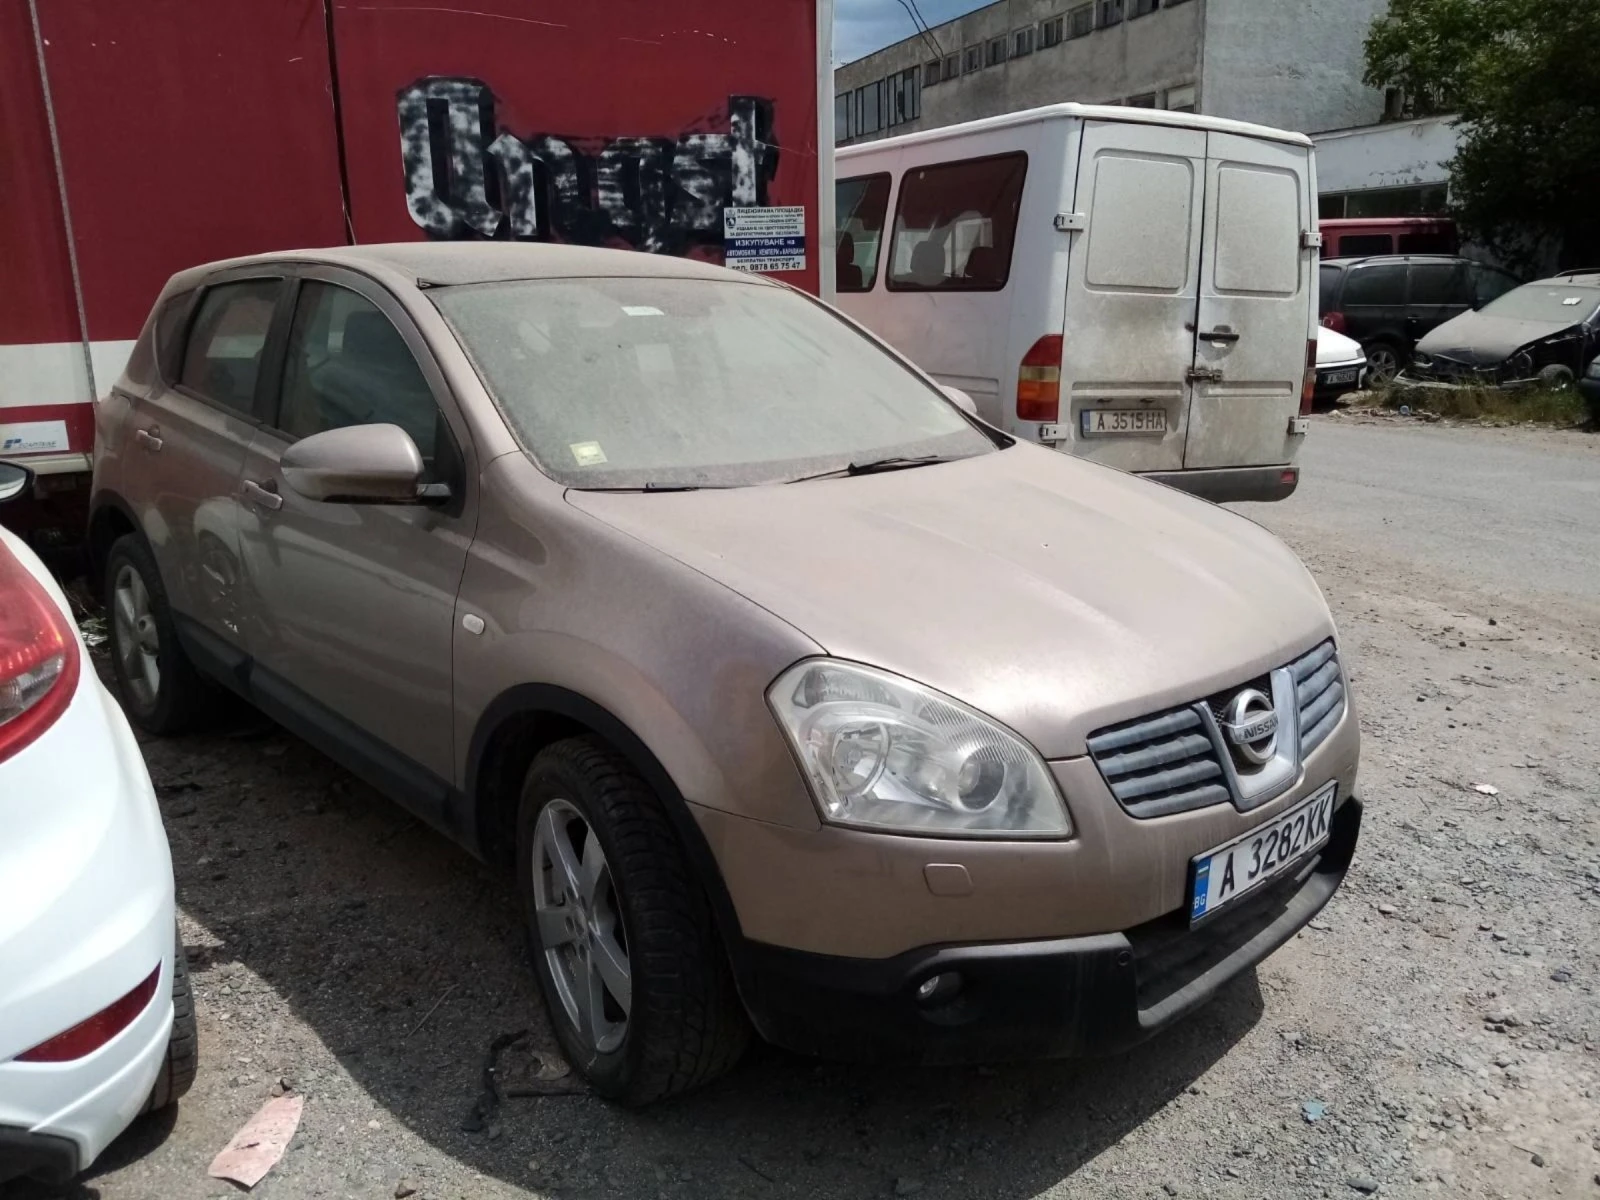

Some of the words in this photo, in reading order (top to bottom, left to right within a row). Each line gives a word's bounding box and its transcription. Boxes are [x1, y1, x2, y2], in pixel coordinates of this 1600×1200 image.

[735, 239, 785, 247] ИЗКУПУВАНЕ
[750, 263, 768, 271] 0878
[1097, 413, 1105, 431] A
[1112, 412, 1163, 430] 3515HA
[1244, 718, 1279, 739] NISSAN
[1219, 852, 1235, 898] A
[1248, 795, 1331, 880] 3282KK
[1193, 892, 1206, 910] BG
